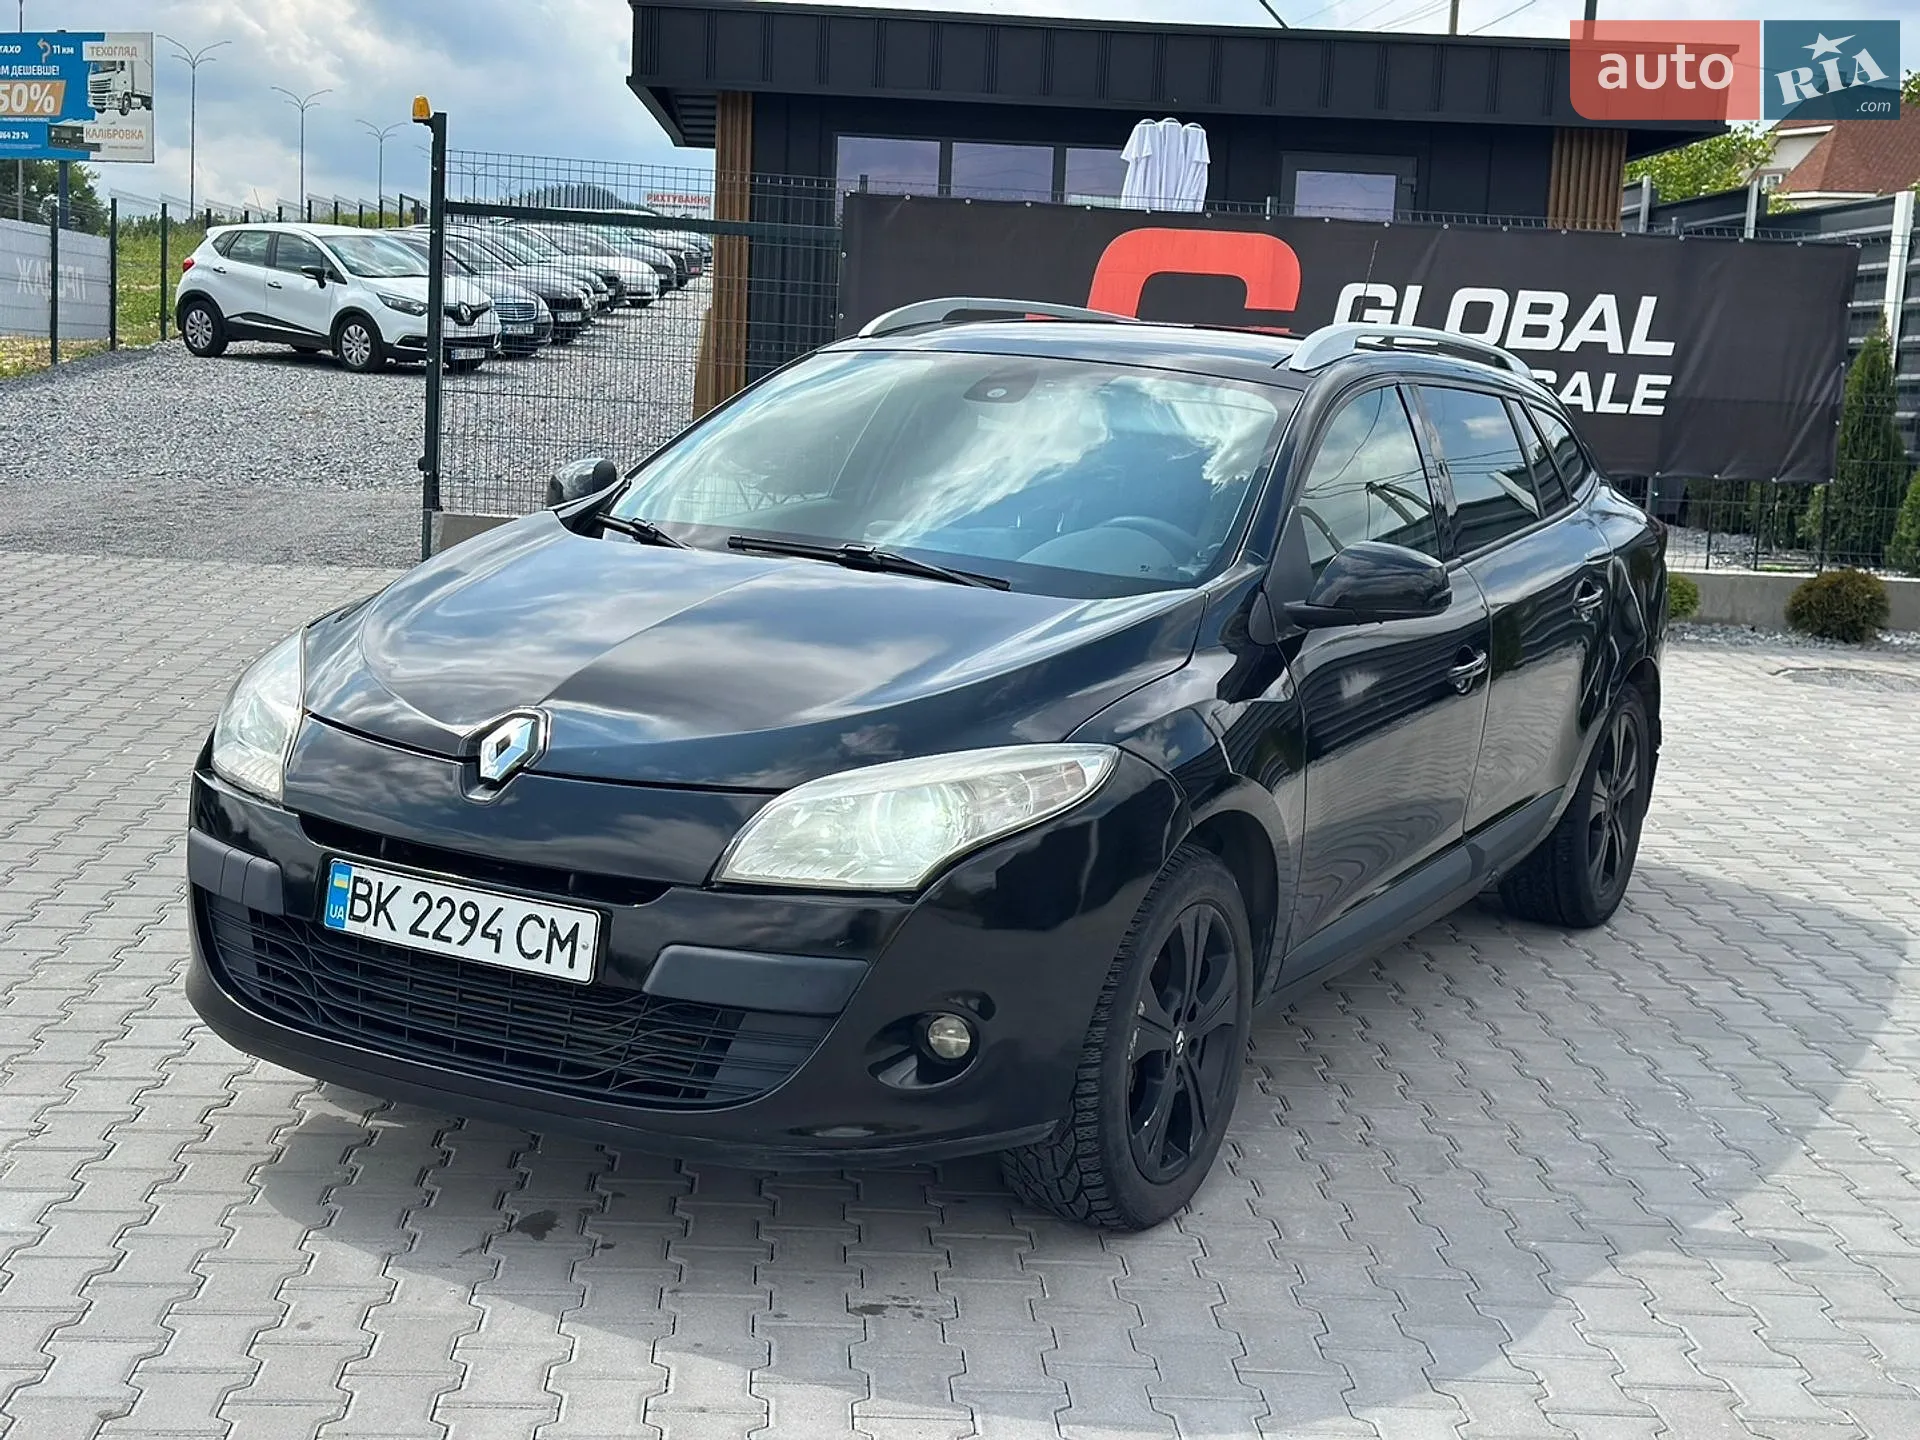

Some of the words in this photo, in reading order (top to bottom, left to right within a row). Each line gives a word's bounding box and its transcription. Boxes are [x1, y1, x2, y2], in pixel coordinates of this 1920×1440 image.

[90, 46, 138, 58] ТЕХОГЛЯД
[10, 65, 60, 77] ДЕШЕВШЕ!
[0, 82, 55, 113] 50%
[85, 127, 145, 140] КАЛІБРОВКА
[646, 193, 711, 205] РИХТУВАННЯ
[1333, 282, 1675, 356] GLOBAL
[329, 903, 345, 920] UA
[348, 876, 402, 931] BK
[408, 890, 504, 954] 2294
[516, 913, 580, 969] CM
